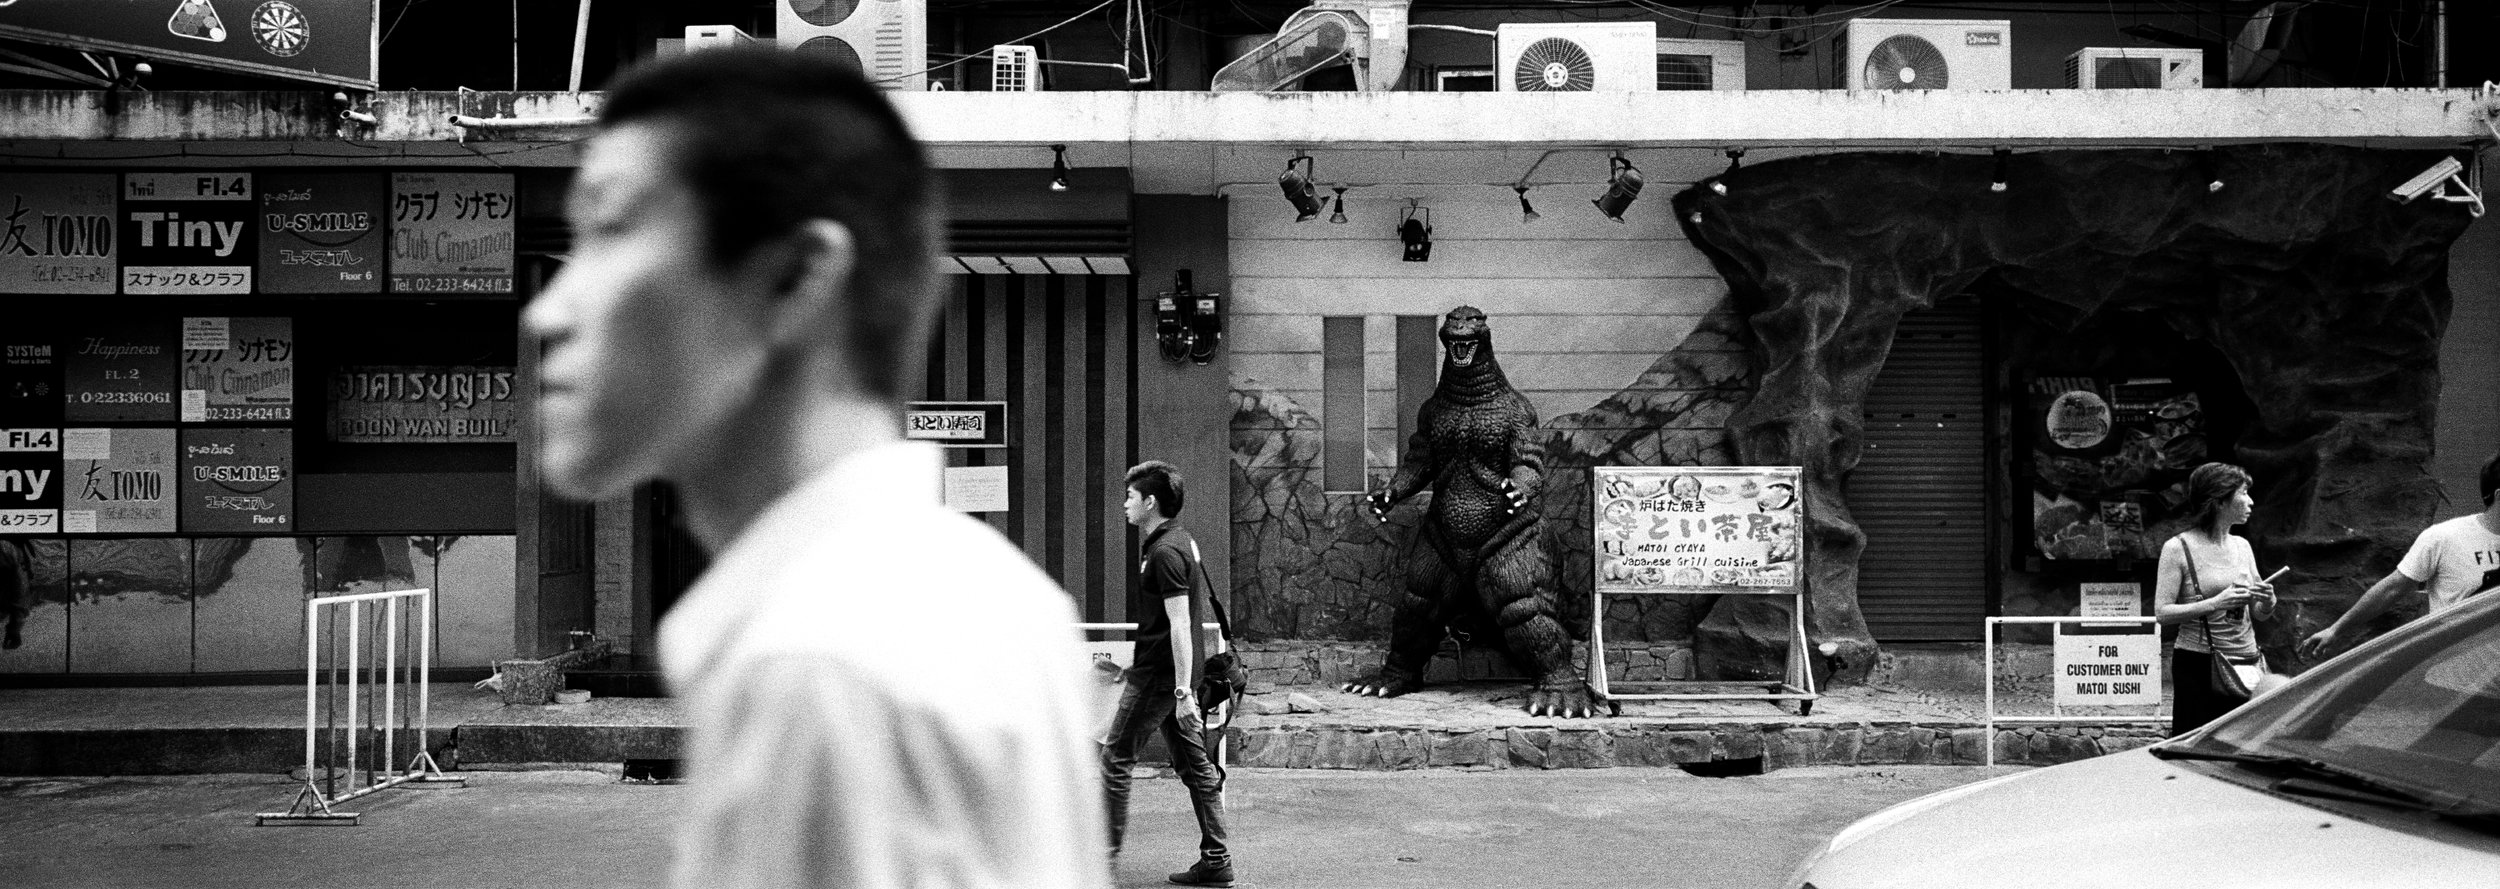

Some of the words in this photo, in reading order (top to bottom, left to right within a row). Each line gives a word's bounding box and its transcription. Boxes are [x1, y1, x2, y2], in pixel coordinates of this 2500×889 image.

[197, 177, 245, 196] Fl.4
[454, 190, 513, 220] シナモン
[0, 194, 39, 257] 友
[266, 211, 369, 232] U-SMILE
[42, 215, 112, 257] TOMO
[131, 212, 244, 257] Tiny
[394, 227, 430, 261] Club
[435, 231, 513, 263] Cinnamon
[340, 271, 363, 281] Floor
[365, 270, 373, 281] 6
[393, 278, 412, 291] Tel.
[416, 278, 493, 291] 02-233-6424
[7, 345, 51, 357] SYSTeM
[78, 337, 161, 360] Happiness
[238, 337, 291, 362] シナモン
[222, 367, 290, 395] Cinnamon
[205, 407, 273, 420] 02-233-6424
[341, 418, 396, 436] BOON
[402, 418, 449, 436] WAN
[9, 432, 53, 448] Fl.4
[79, 459, 108, 501] 友
[193, 466, 280, 481] U-SMILE
[110, 471, 161, 500] TOMO
[1639, 500, 1706, 513] 炉はた焼き
[253, 515, 276, 524] Floor
[278, 515, 286, 524] 6
[1638, 544, 1667, 553] MATOI
[1674, 544, 1706, 553] CYAYA
[1622, 557, 1671, 567] Japanese
[1677, 557, 1707, 567] Grill
[2098, 645, 2119, 658] FOR
[2067, 664, 2122, 676] CUSTOMER
[2124, 664, 2150, 676] ONLY
[2076, 682, 2107, 695] MATOI
[2112, 682, 2141, 695] SUSHI
